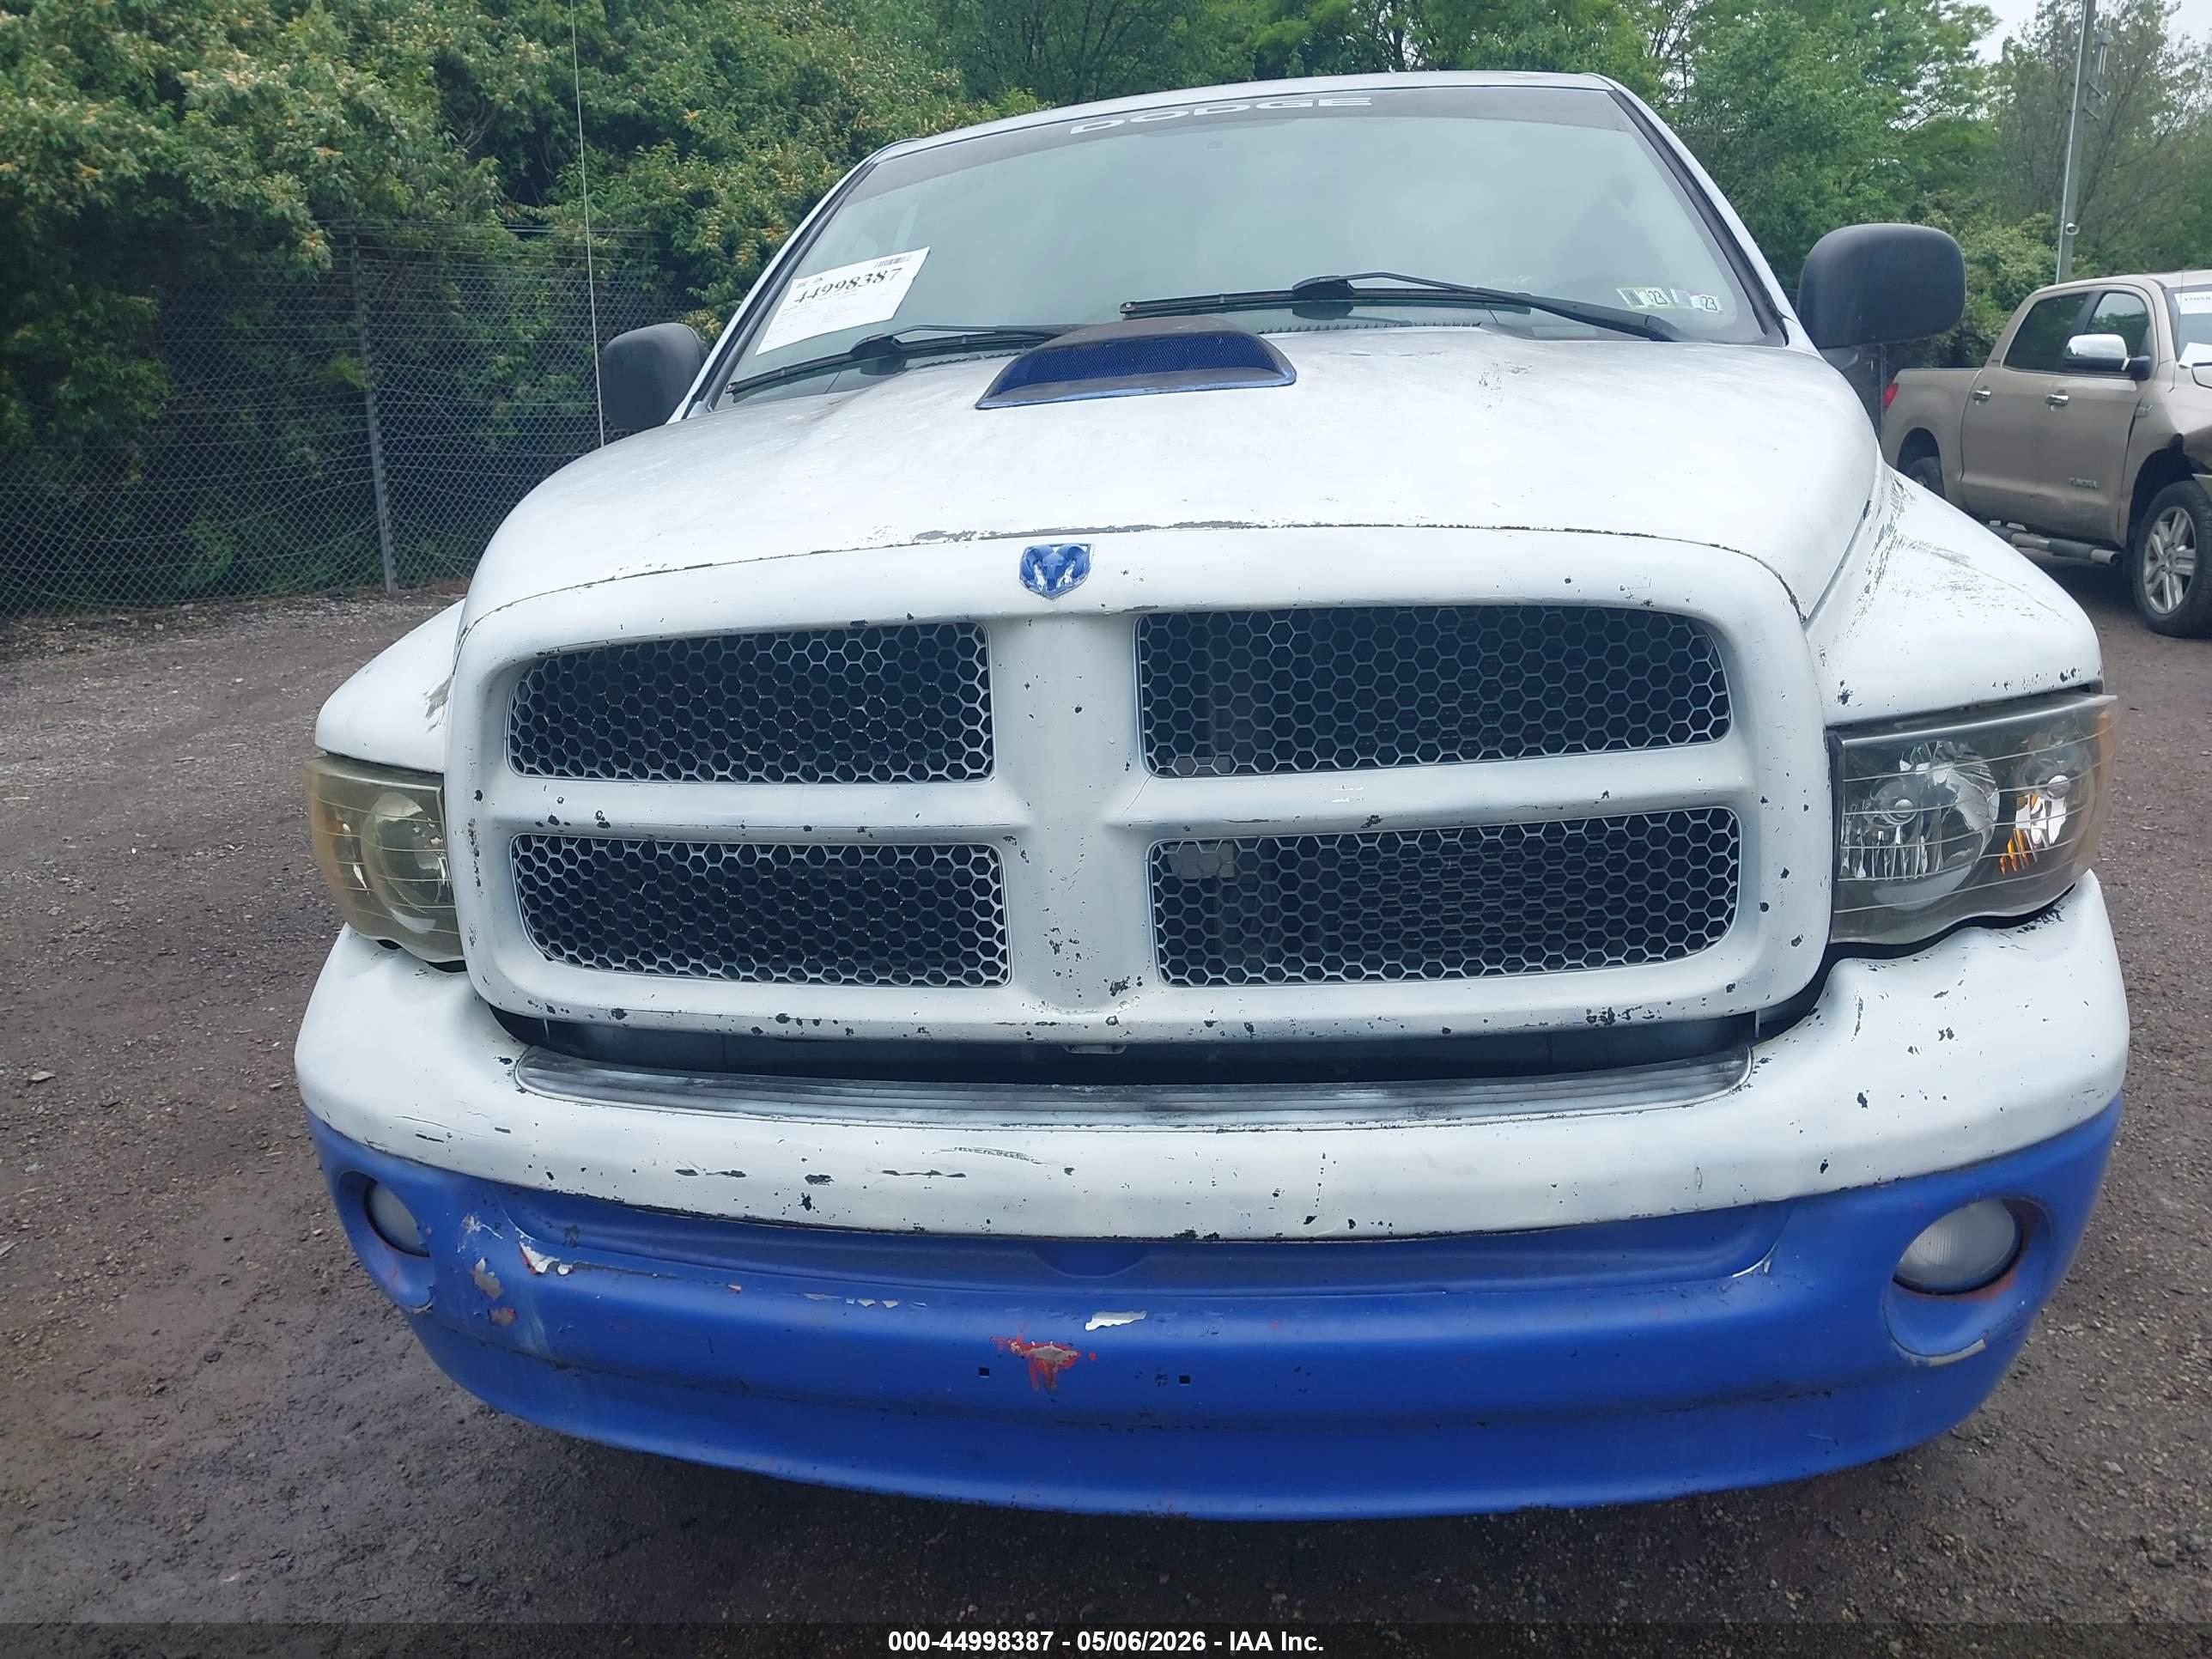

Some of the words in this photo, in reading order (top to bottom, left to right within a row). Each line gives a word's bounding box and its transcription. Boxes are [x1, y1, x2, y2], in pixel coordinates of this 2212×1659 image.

[1069, 97, 1372, 135] DODGE
[794, 267, 902, 304] 44998387
[1648, 289, 1668, 305] 23
[1701, 295, 1718, 311] 23
